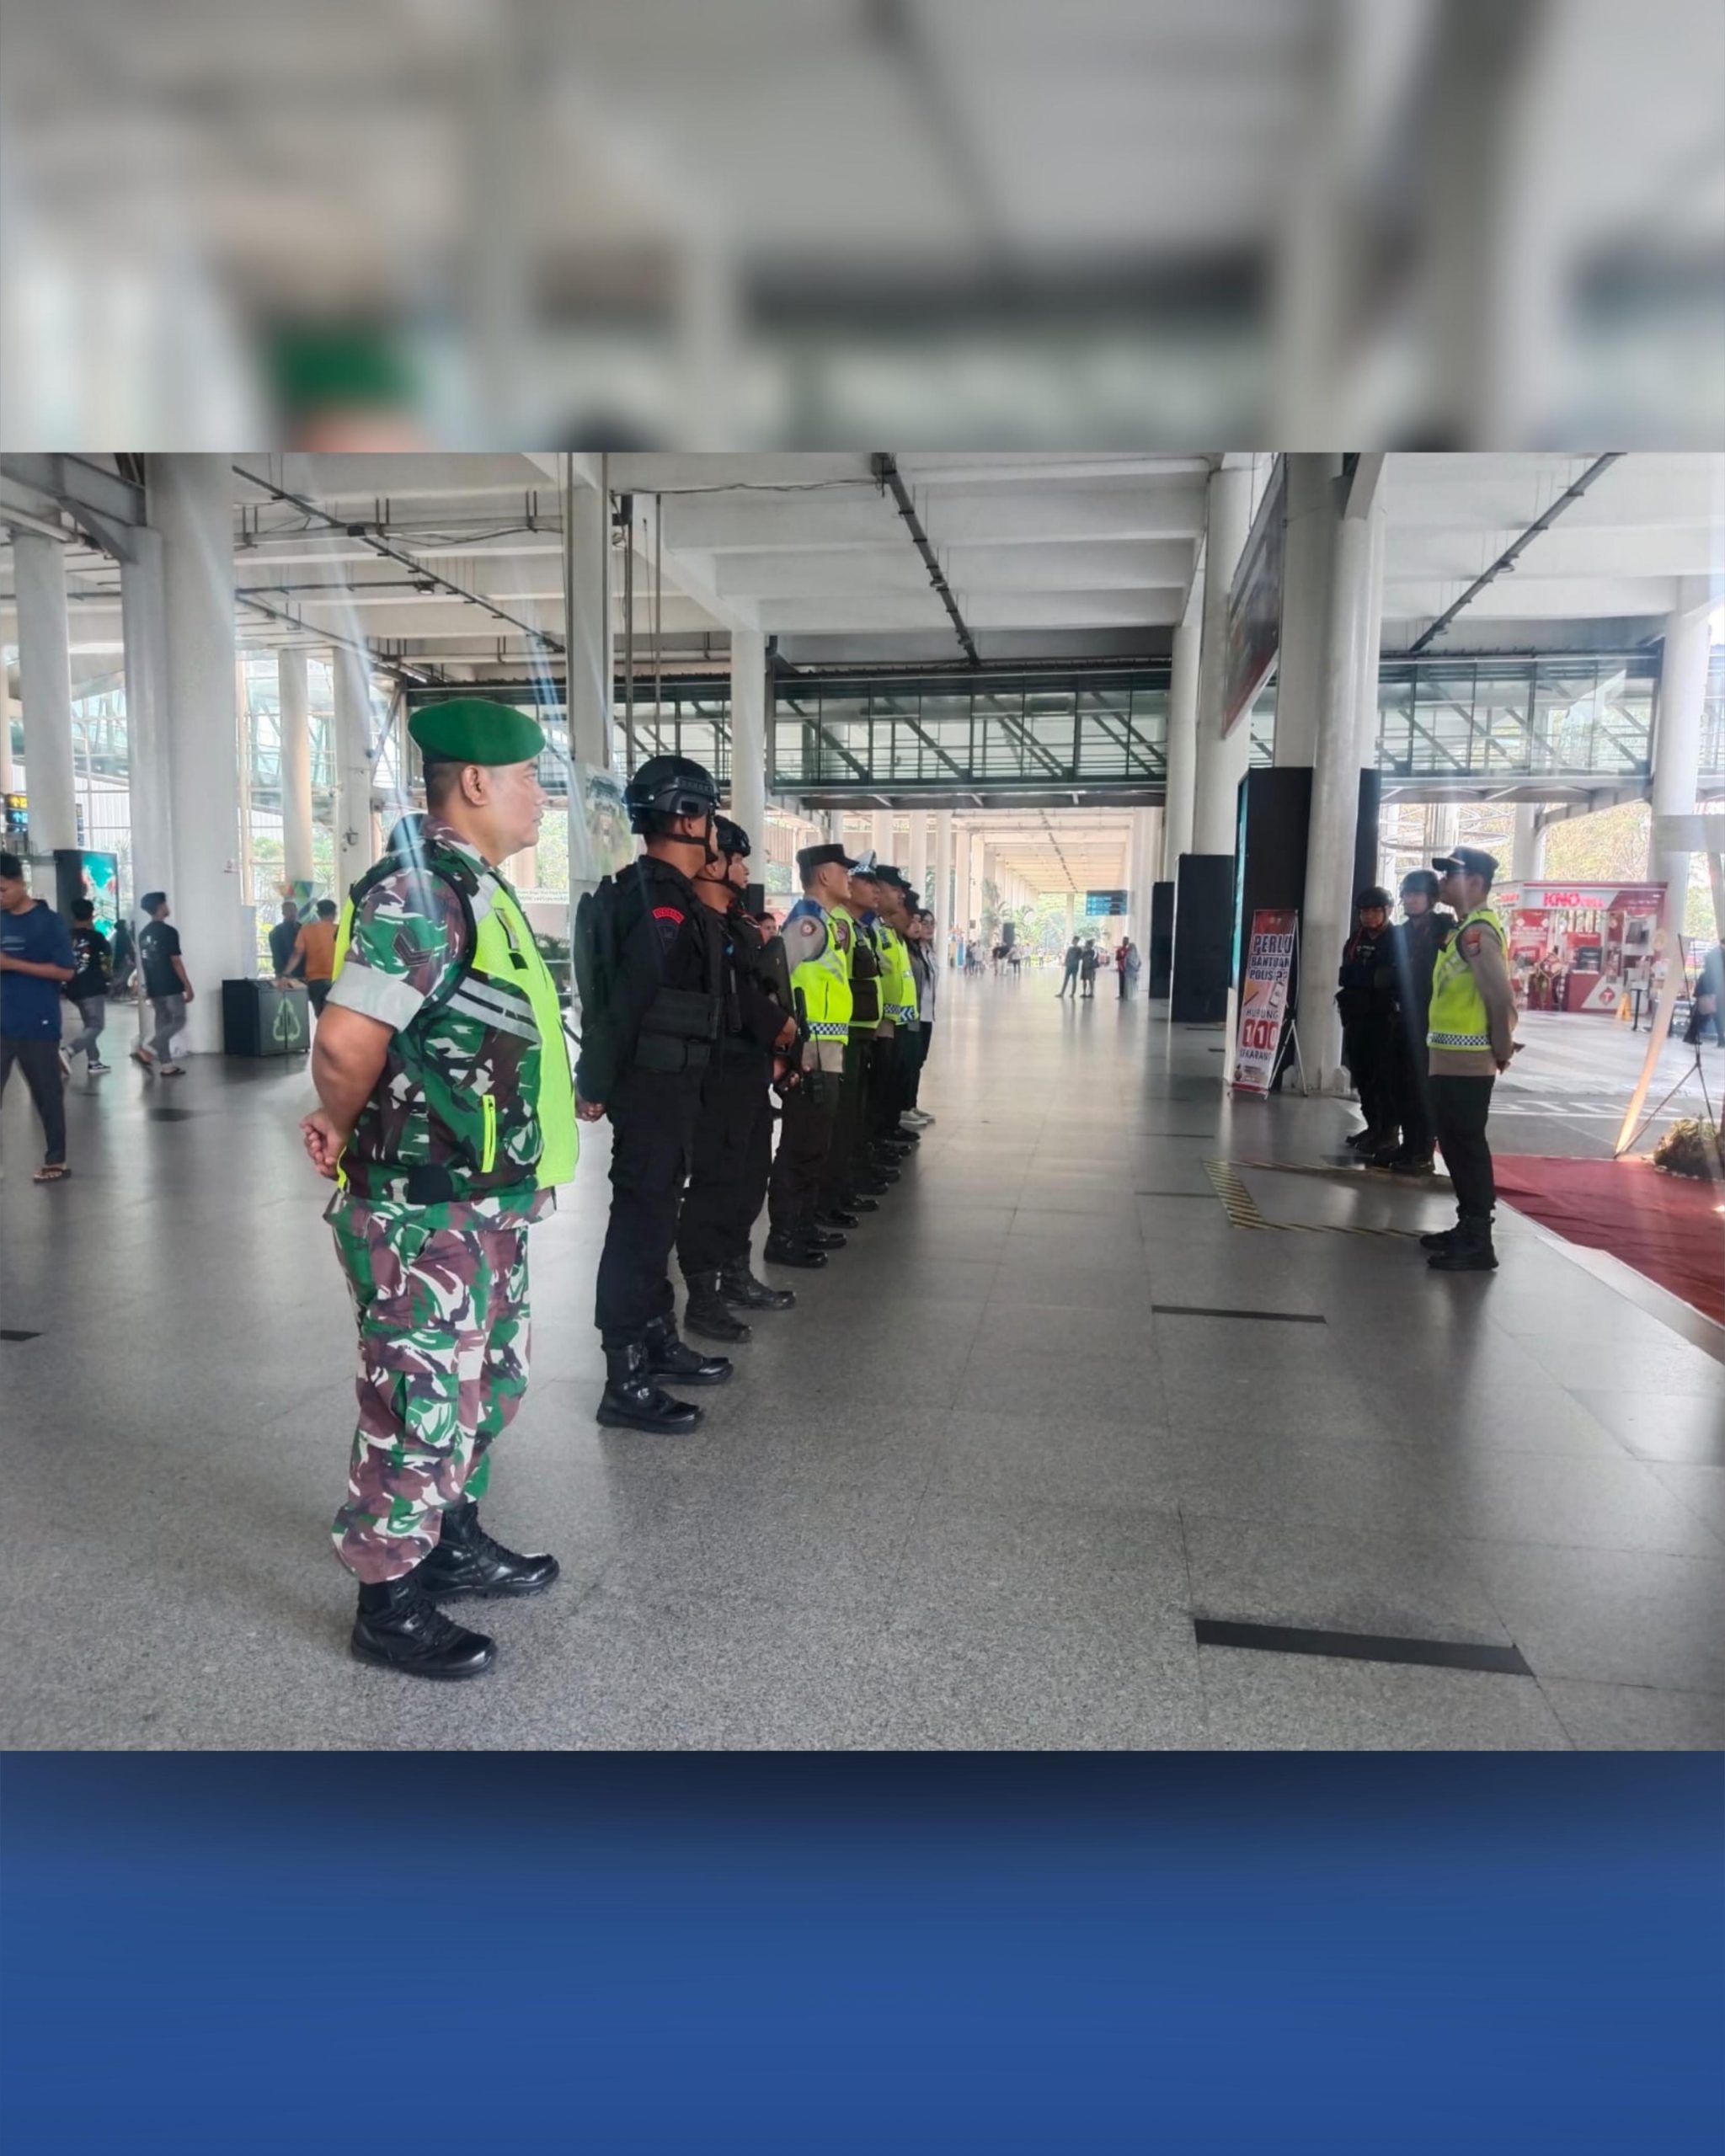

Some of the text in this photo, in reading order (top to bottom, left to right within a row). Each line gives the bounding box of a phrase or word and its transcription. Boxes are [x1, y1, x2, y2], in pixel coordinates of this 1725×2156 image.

[1252, 935, 1293, 953] PERLU
[1251, 957, 1290, 968] BANTUAN
[1244, 1022, 1278, 1048] 110
